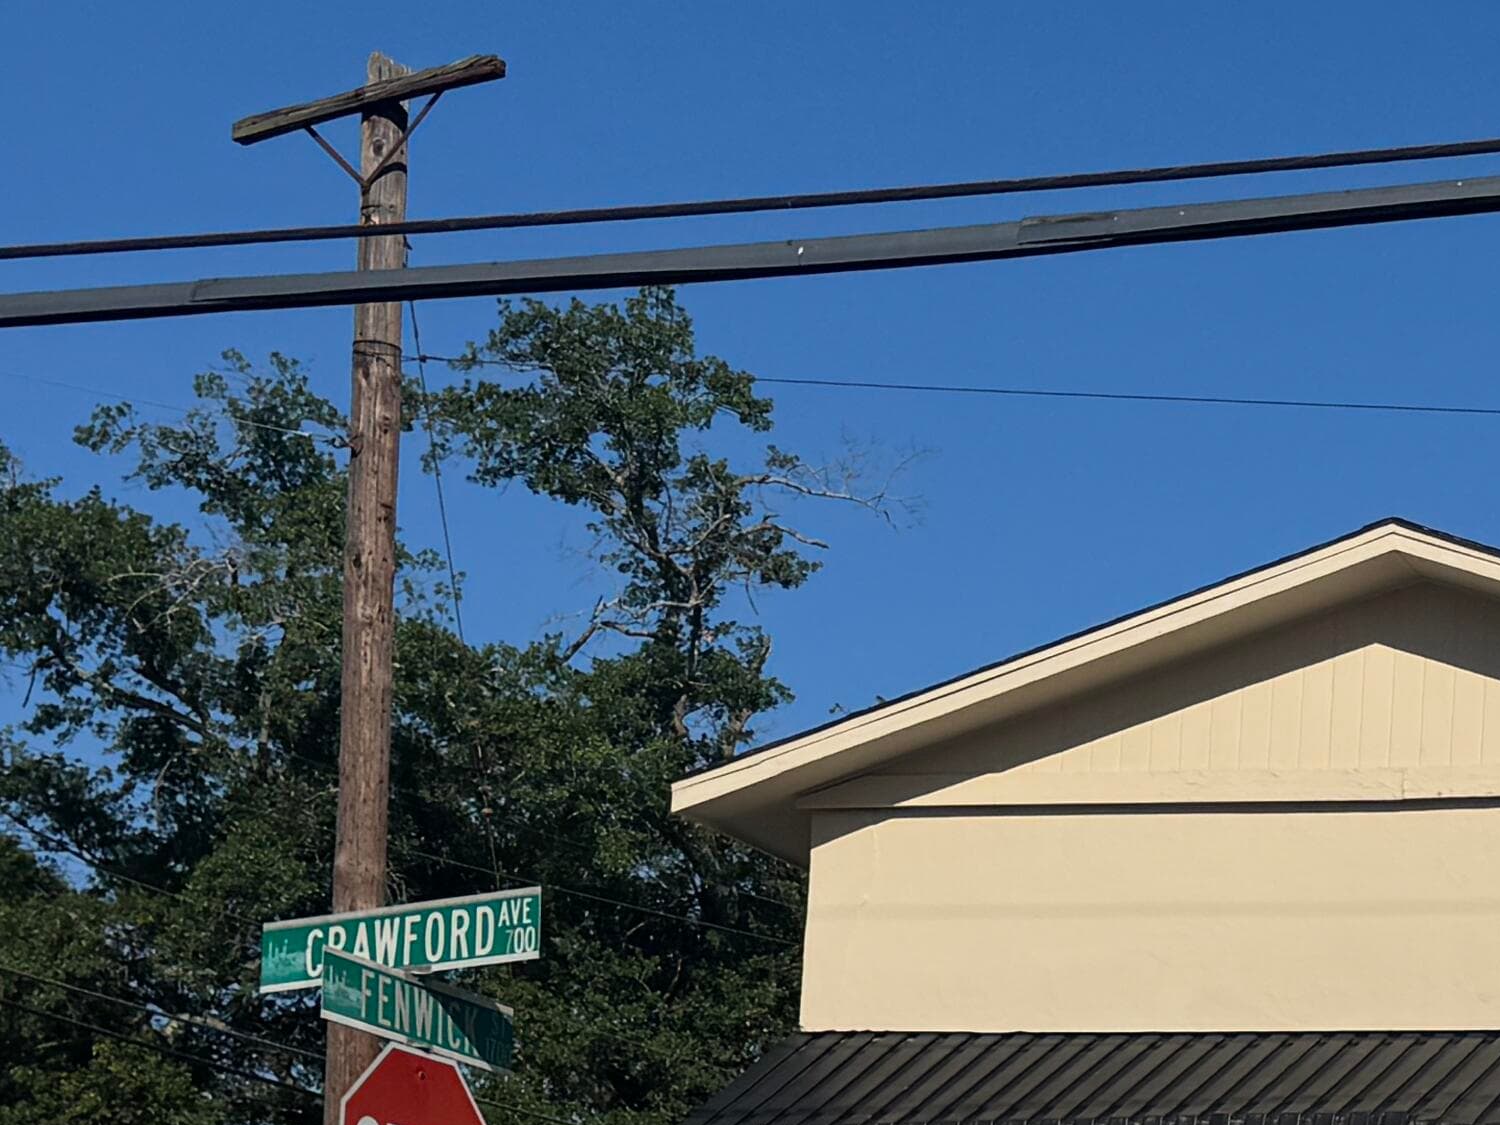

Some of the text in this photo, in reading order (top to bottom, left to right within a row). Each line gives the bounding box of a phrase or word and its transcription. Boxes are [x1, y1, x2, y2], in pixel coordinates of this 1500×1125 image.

[305, 898, 532, 977] CRAWFORD AVE
[505, 927, 536, 954] 700
[361, 969, 480, 1057] FENWICK
